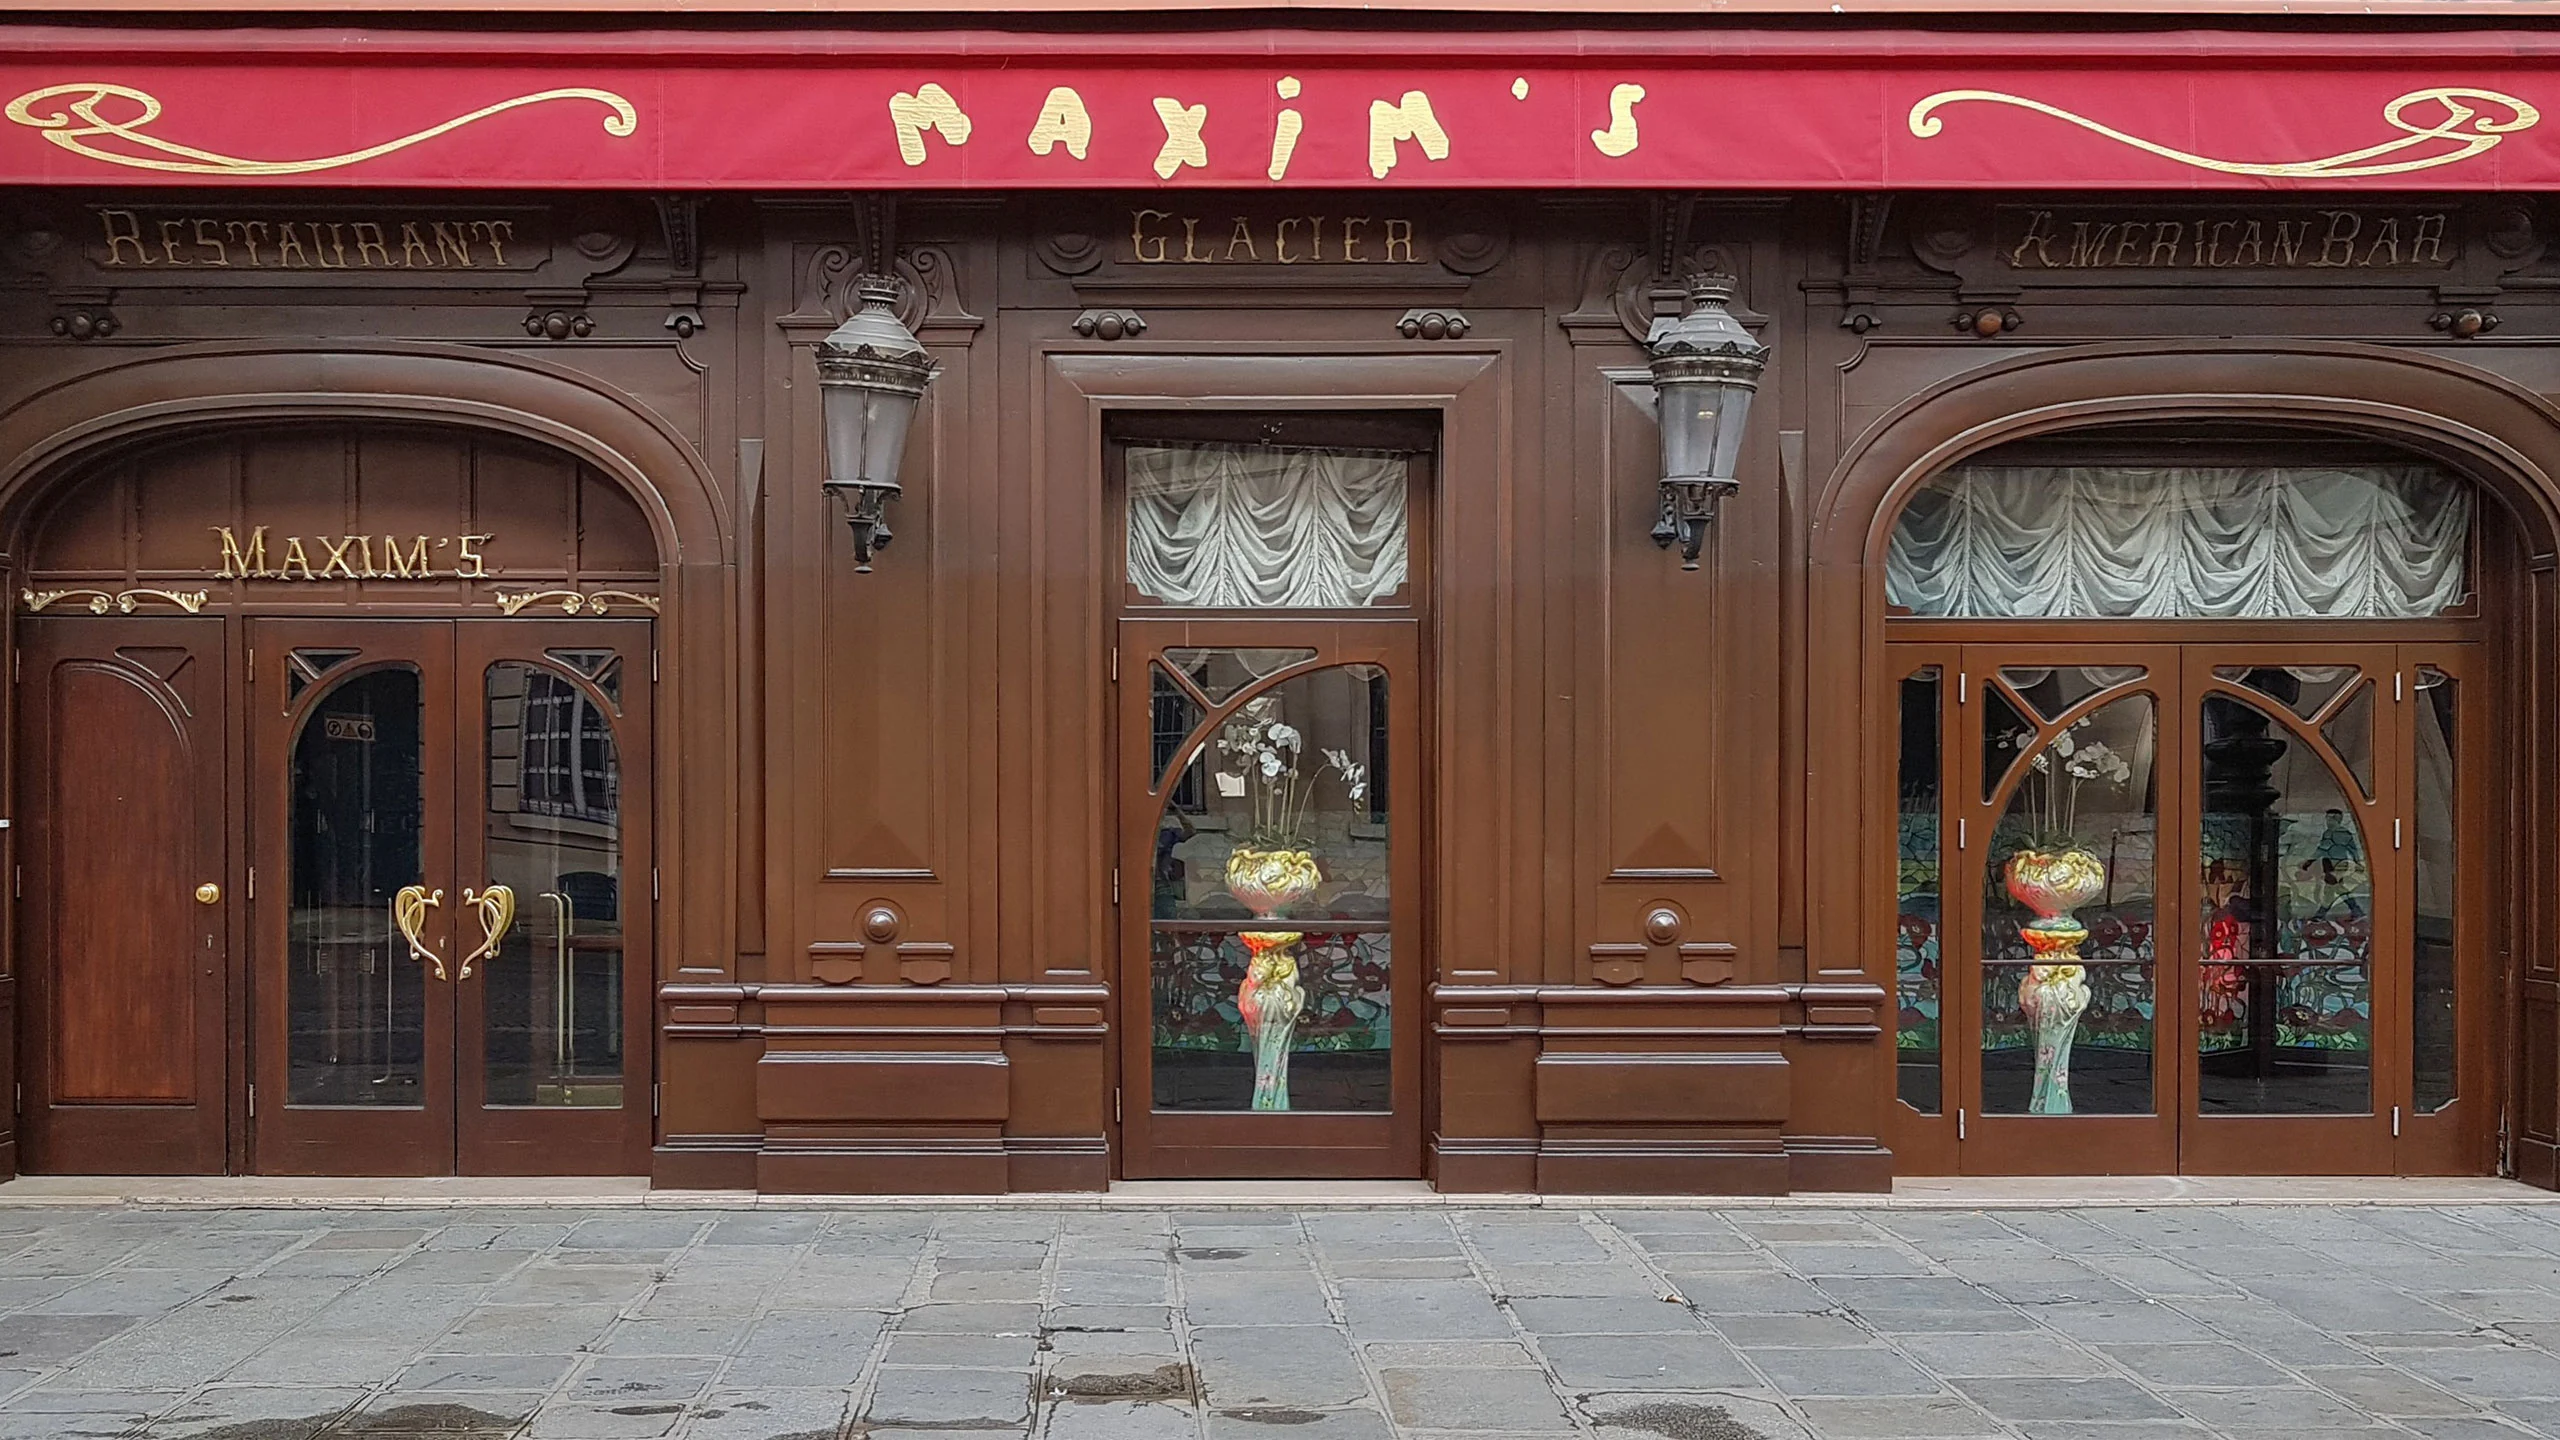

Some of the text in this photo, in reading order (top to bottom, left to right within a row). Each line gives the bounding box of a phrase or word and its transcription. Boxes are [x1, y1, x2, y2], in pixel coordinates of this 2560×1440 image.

[98, 208, 513, 269] RESTAURANT
[1131, 208, 1420, 265] GLACIER
[2011, 209, 2456, 269] AMERICAN BAR
[207, 525, 496, 581] MAXIM'S
